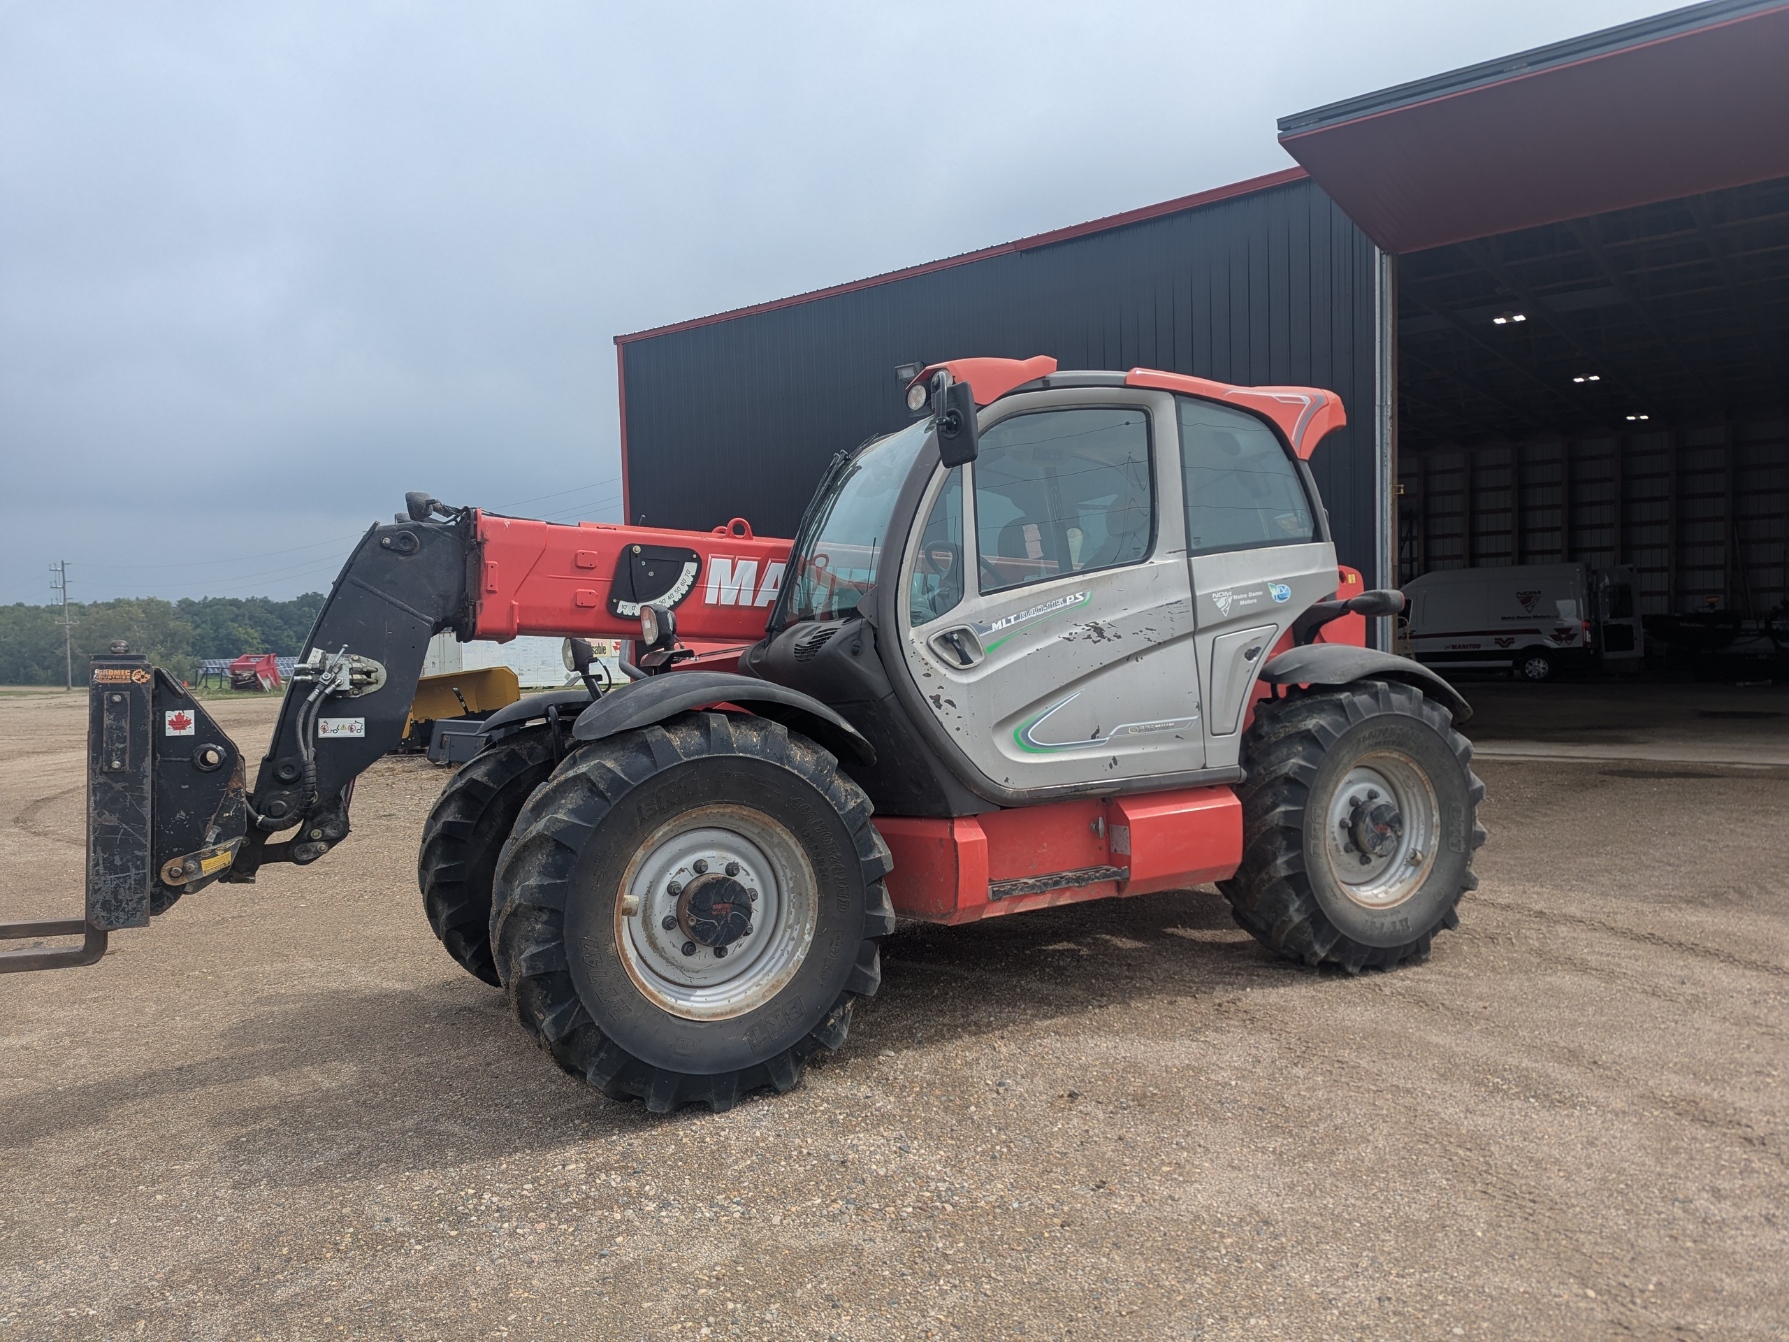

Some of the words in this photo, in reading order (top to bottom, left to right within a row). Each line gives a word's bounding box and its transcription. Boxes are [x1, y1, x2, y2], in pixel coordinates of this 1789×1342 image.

[991, 614, 1017, 632] MLT
[1065, 591, 1085, 605] PS
[1239, 598, 1257, 606] Motors
[579, 936, 608, 985] 747
